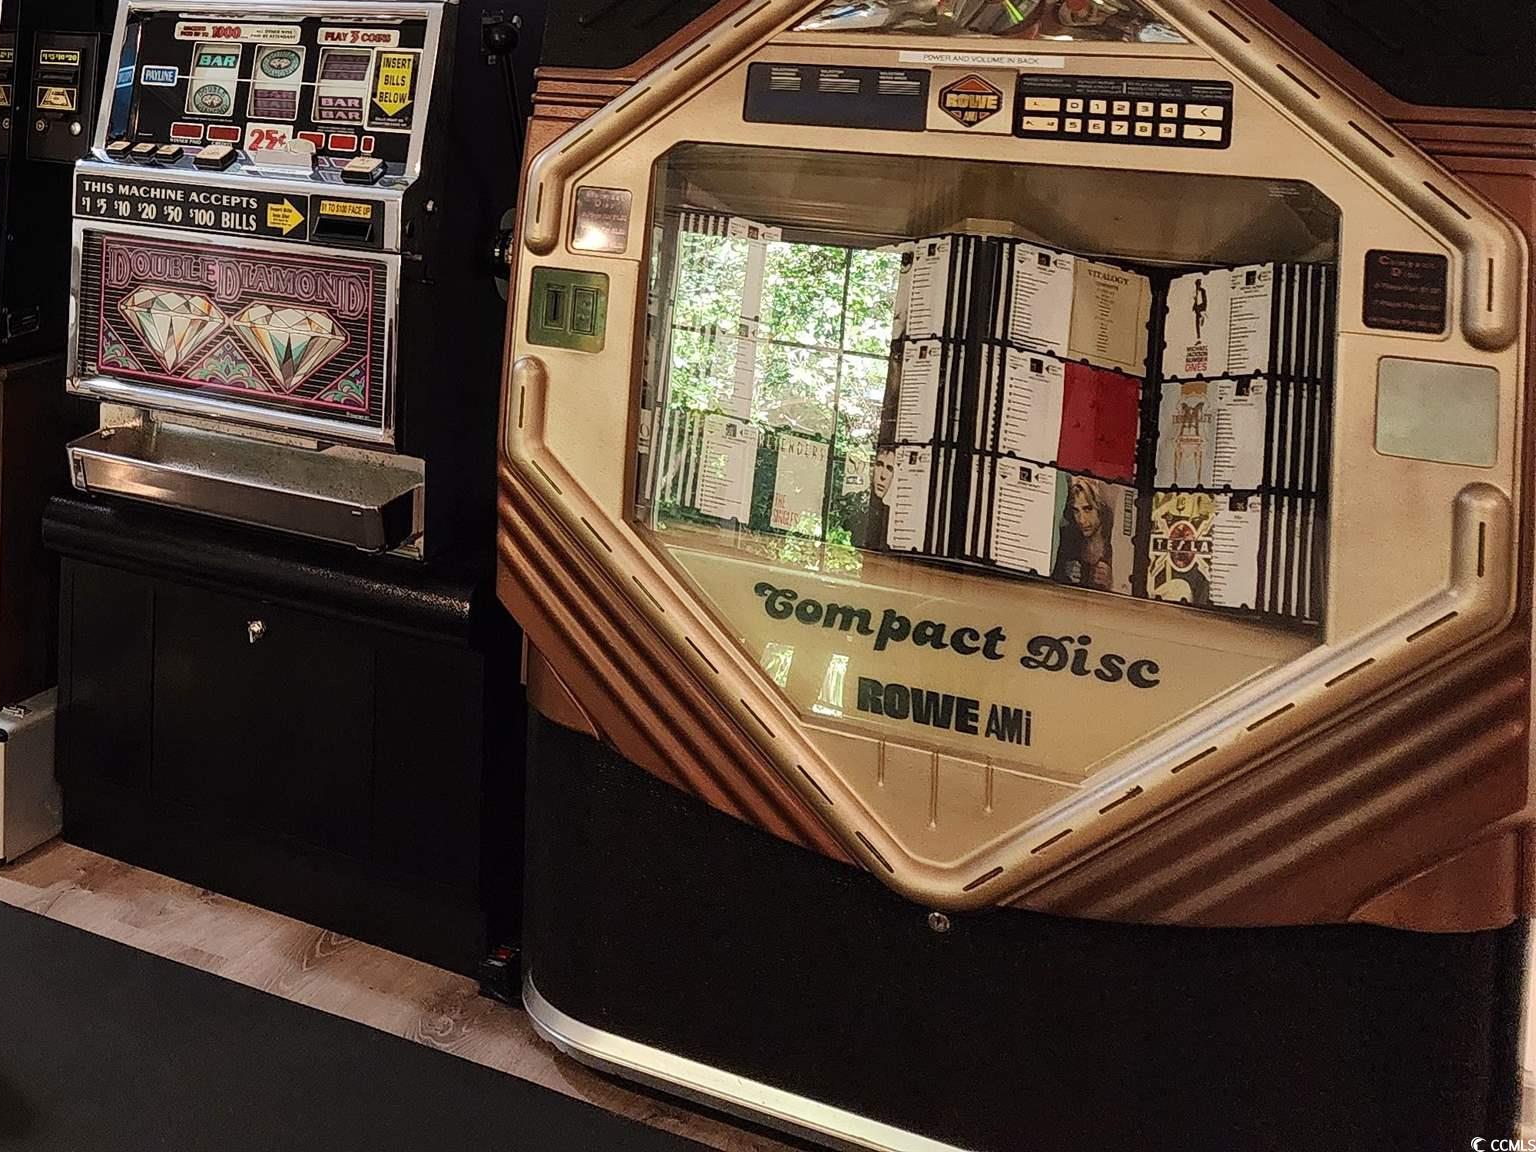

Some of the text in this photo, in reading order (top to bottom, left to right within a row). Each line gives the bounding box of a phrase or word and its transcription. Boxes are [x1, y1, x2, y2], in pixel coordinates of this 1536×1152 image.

[211, 26, 242, 39] 1000
[324, 30, 392, 43] PLAY 3 COINS
[198, 55, 236, 67] BAR
[383, 57, 412, 69] INSERT
[145, 69, 174, 82] PAYLINE
[384, 75, 406, 87] BILLS
[321, 98, 360, 107] BAR
[379, 91, 408, 104] BELOW
[946, 93, 999, 109] ROWE
[321, 111, 361, 119] BAR
[1140, 105, 1149, 113] 3
[1163, 126, 1172, 134] 9
[249, 129, 287, 152] 25¢
[82, 180, 259, 209] THIS MACHINE ACCEPTS
[82, 198, 91, 213] $1
[96, 198, 107, 215] $5
[114, 200, 131, 218] $10
[137, 201, 157, 220] $20
[163, 204, 183, 223] $50
[189, 206, 215, 228] $100
[221, 212, 257, 232] BILLS
[328, 203, 336, 212] TO
[348, 205, 362, 215] FACE
[362, 206, 371, 215] UP
[108, 245, 366, 320] DOUBLE DIAMOND
[1088, 269, 1129, 286] VITALOGY
[1185, 363, 1207, 372] ONES
[753, 580, 1162, 689] Compact Disc
[856, 676, 979, 735] ROWE
